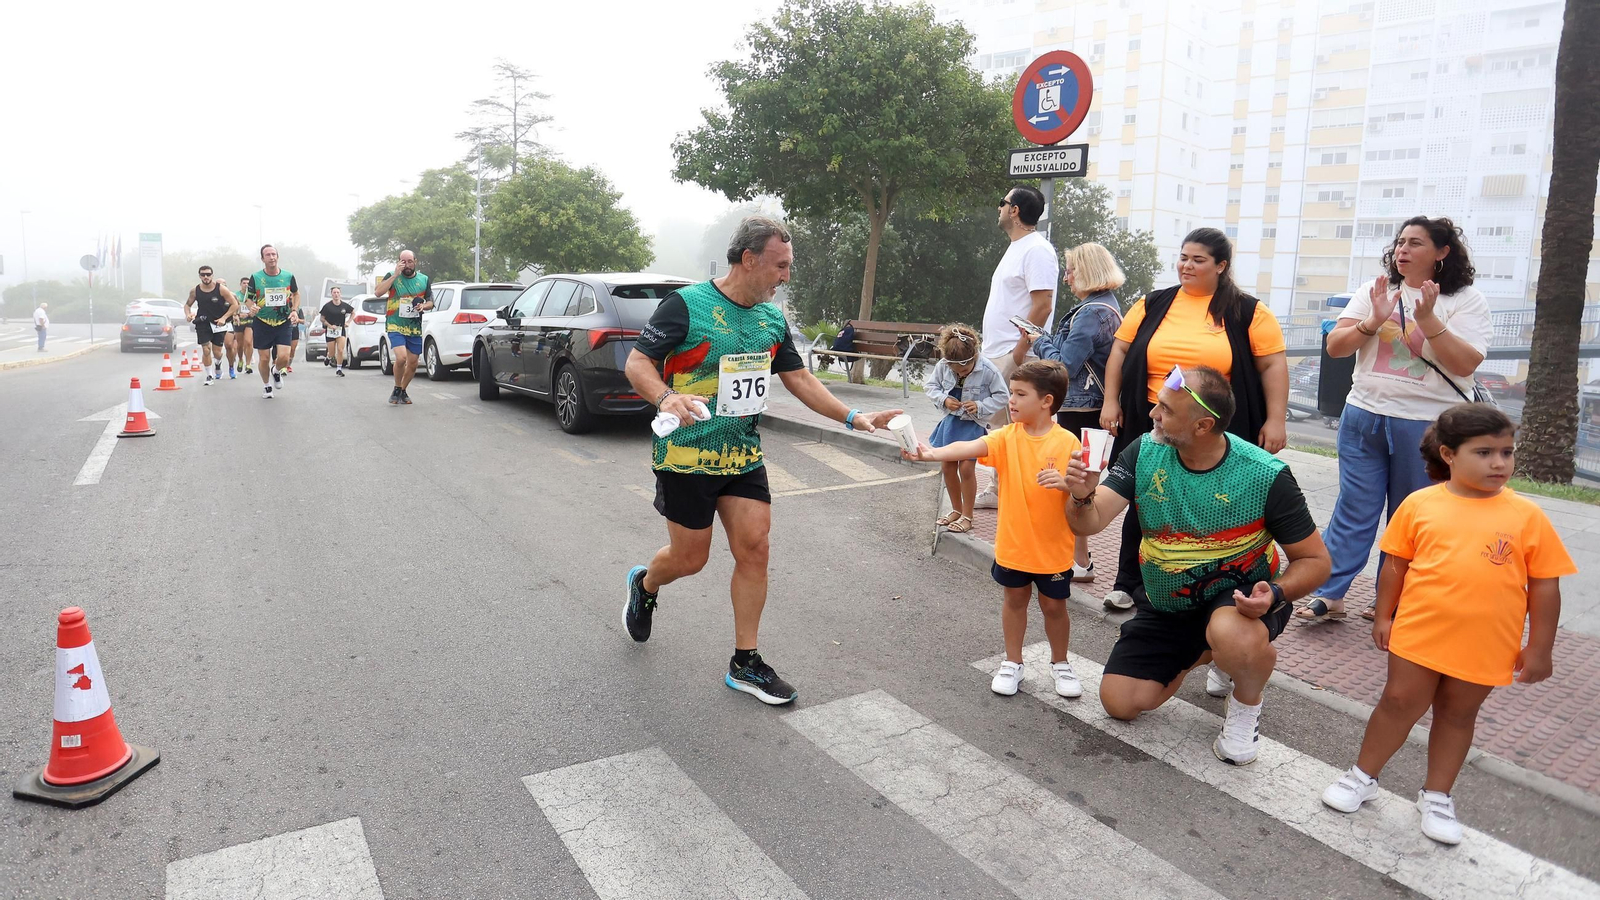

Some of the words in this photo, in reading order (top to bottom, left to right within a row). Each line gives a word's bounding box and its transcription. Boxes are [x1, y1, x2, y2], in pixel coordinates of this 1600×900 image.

[1036, 78, 1065, 89] EXCEPTO
[1024, 151, 1067, 162] EXCEPTO
[1013, 162, 1077, 173] MINUSVALIDO
[269, 294, 284, 302] 399
[731, 377, 766, 400] 376
